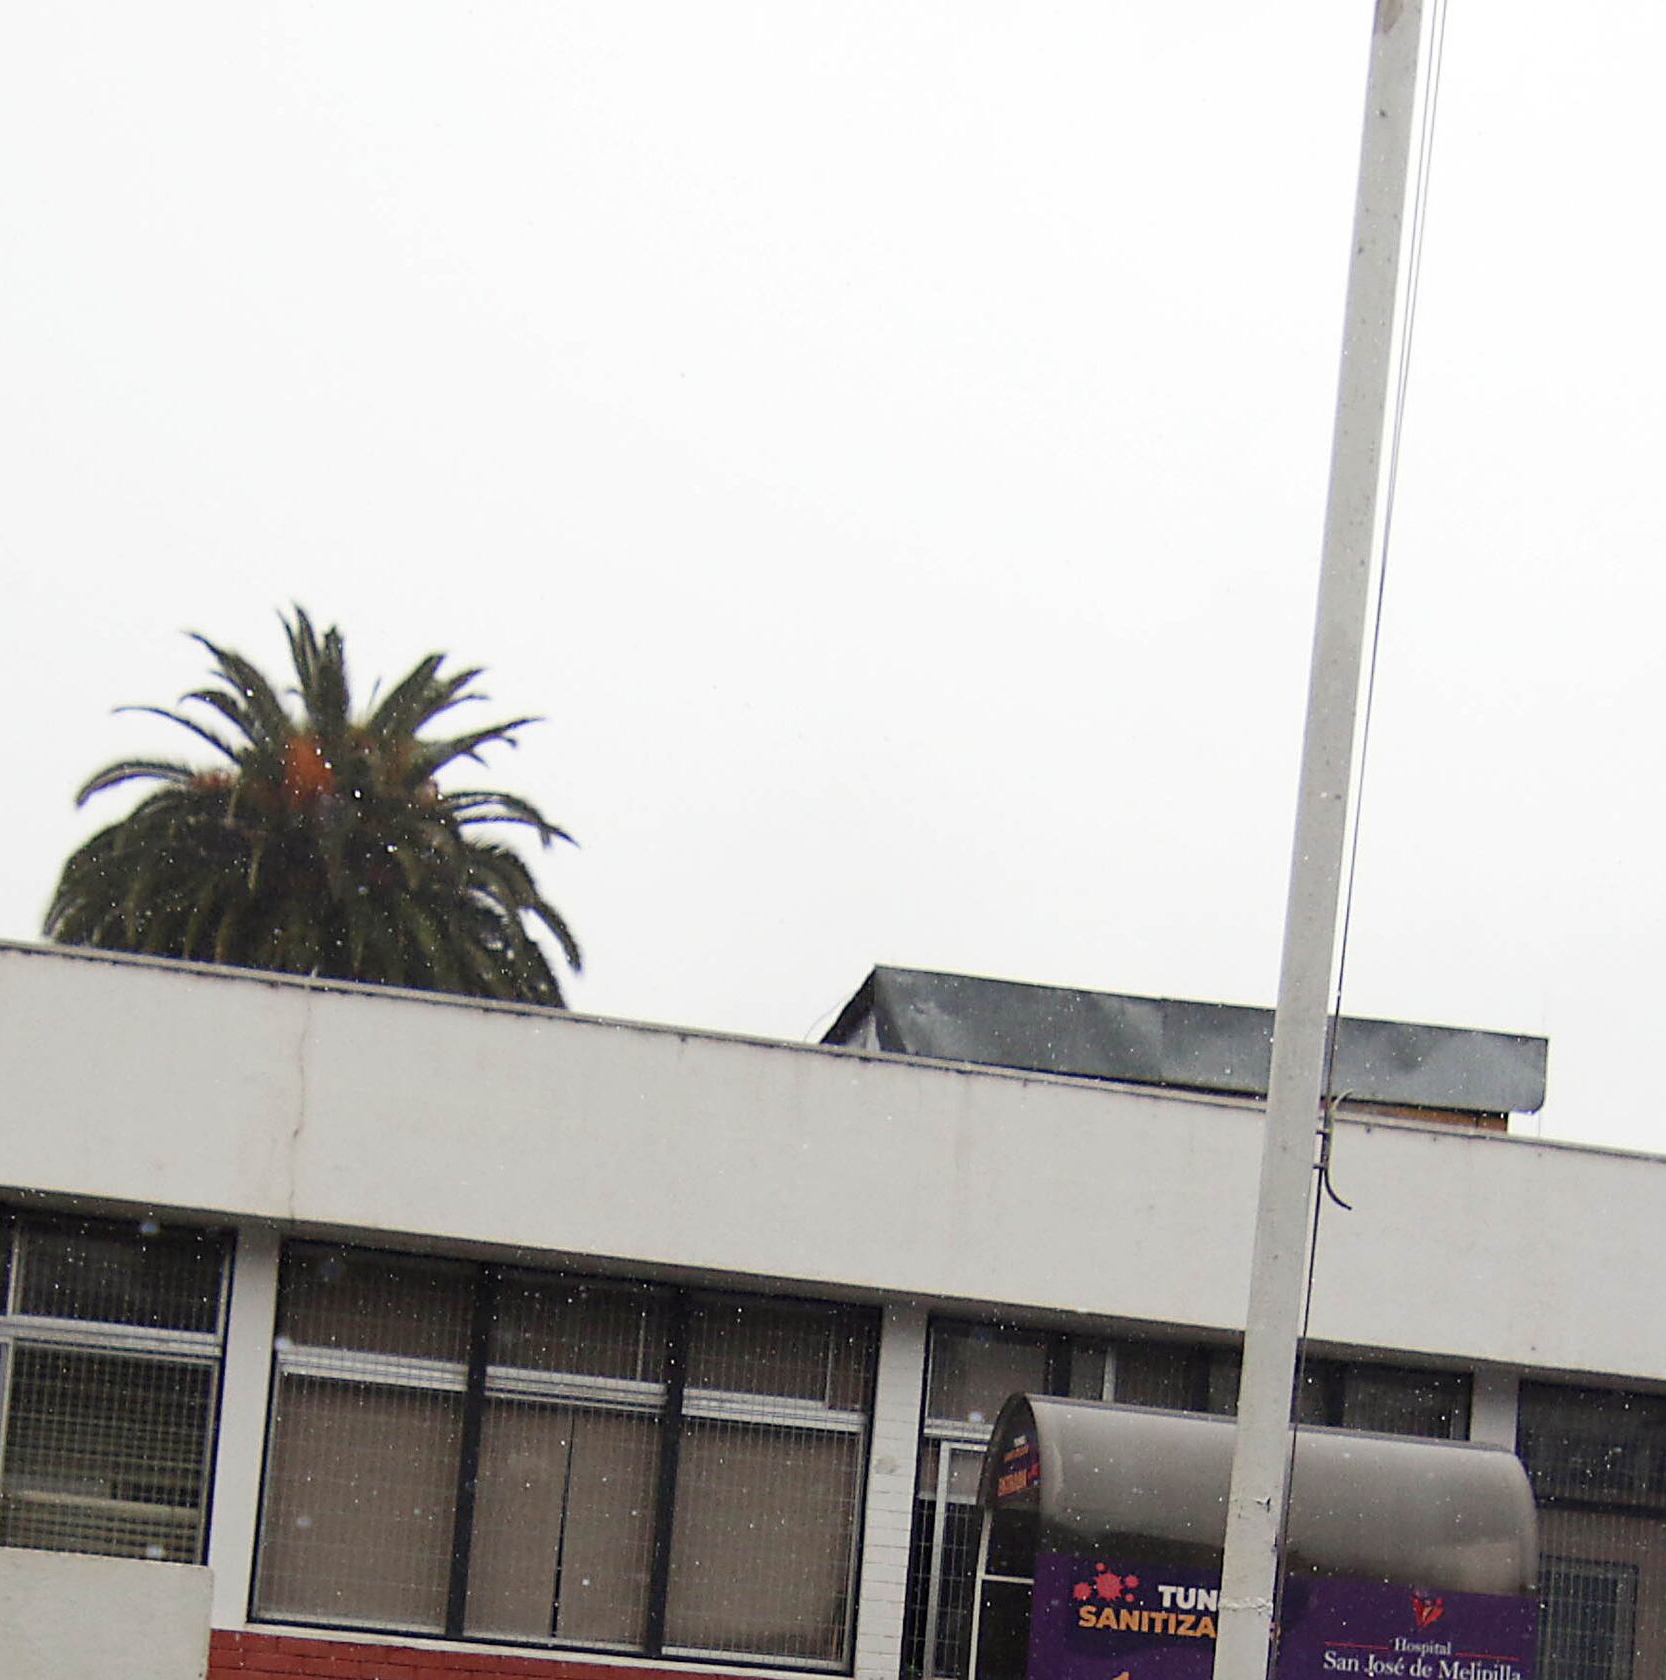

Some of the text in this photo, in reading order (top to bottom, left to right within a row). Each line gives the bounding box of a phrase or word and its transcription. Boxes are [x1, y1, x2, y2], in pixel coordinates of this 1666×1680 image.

[1394, 1637, 1452, 1658] Hospital
[1323, 1650, 1359, 1672] San
[1364, 1653, 1405, 1676] José
[1409, 1657, 1433, 1678] de
